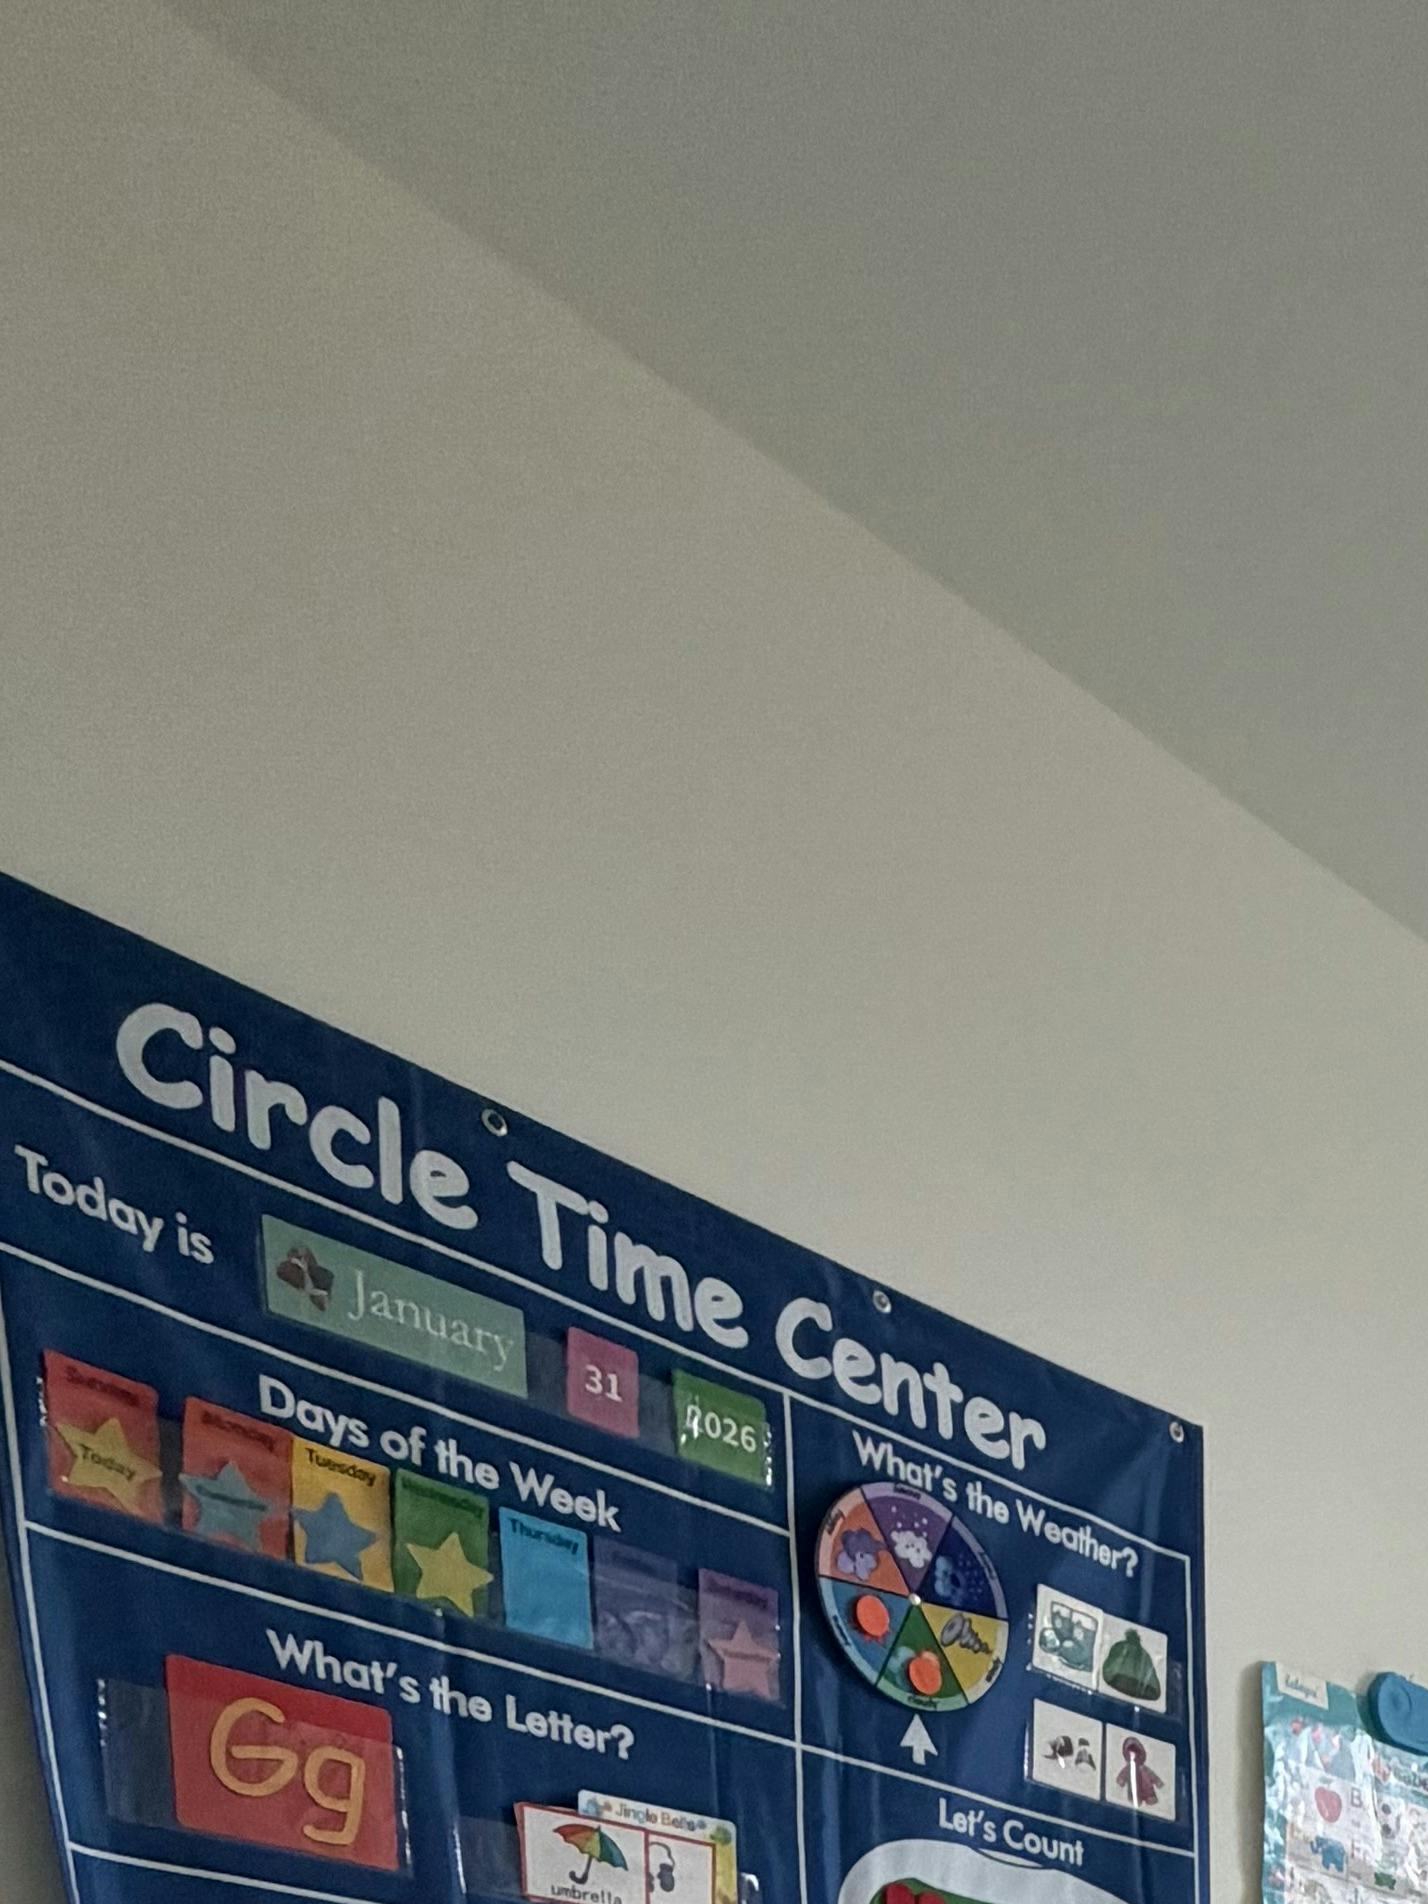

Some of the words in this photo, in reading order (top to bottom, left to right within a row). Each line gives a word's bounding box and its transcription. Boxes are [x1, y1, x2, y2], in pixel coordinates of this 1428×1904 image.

[14, 1145, 165, 1255] Today
[176, 1212, 215, 1266] is
[116, 1002, 478, 1231] Circle
[508, 1161, 750, 1350] Time
[775, 1296, 1047, 1470] Center
[347, 1269, 516, 1371] January
[583, 1364, 624, 1403] 31
[78, 1443, 137, 1482] Today
[258, 1372, 369, 1451] Days
[380, 1426, 427, 1467] of
[435, 1438, 500, 1491] the
[508, 1460, 622, 1534] Week
[304, 1447, 377, 1488] Tuesday
[850, 1429, 959, 1506] What's
[965, 1478, 1010, 1526] the
[1015, 1500, 1140, 1578] Weather?
[509, 1517, 580, 1556] Thursday
[265, 1628, 423, 1704] What's
[428, 1677, 493, 1724] the
[505, 1694, 635, 1761] Letter?
[208, 1696, 367, 1847] Gg
[938, 1797, 997, 1846] Let's
[1002, 1820, 1086, 1867] Count
